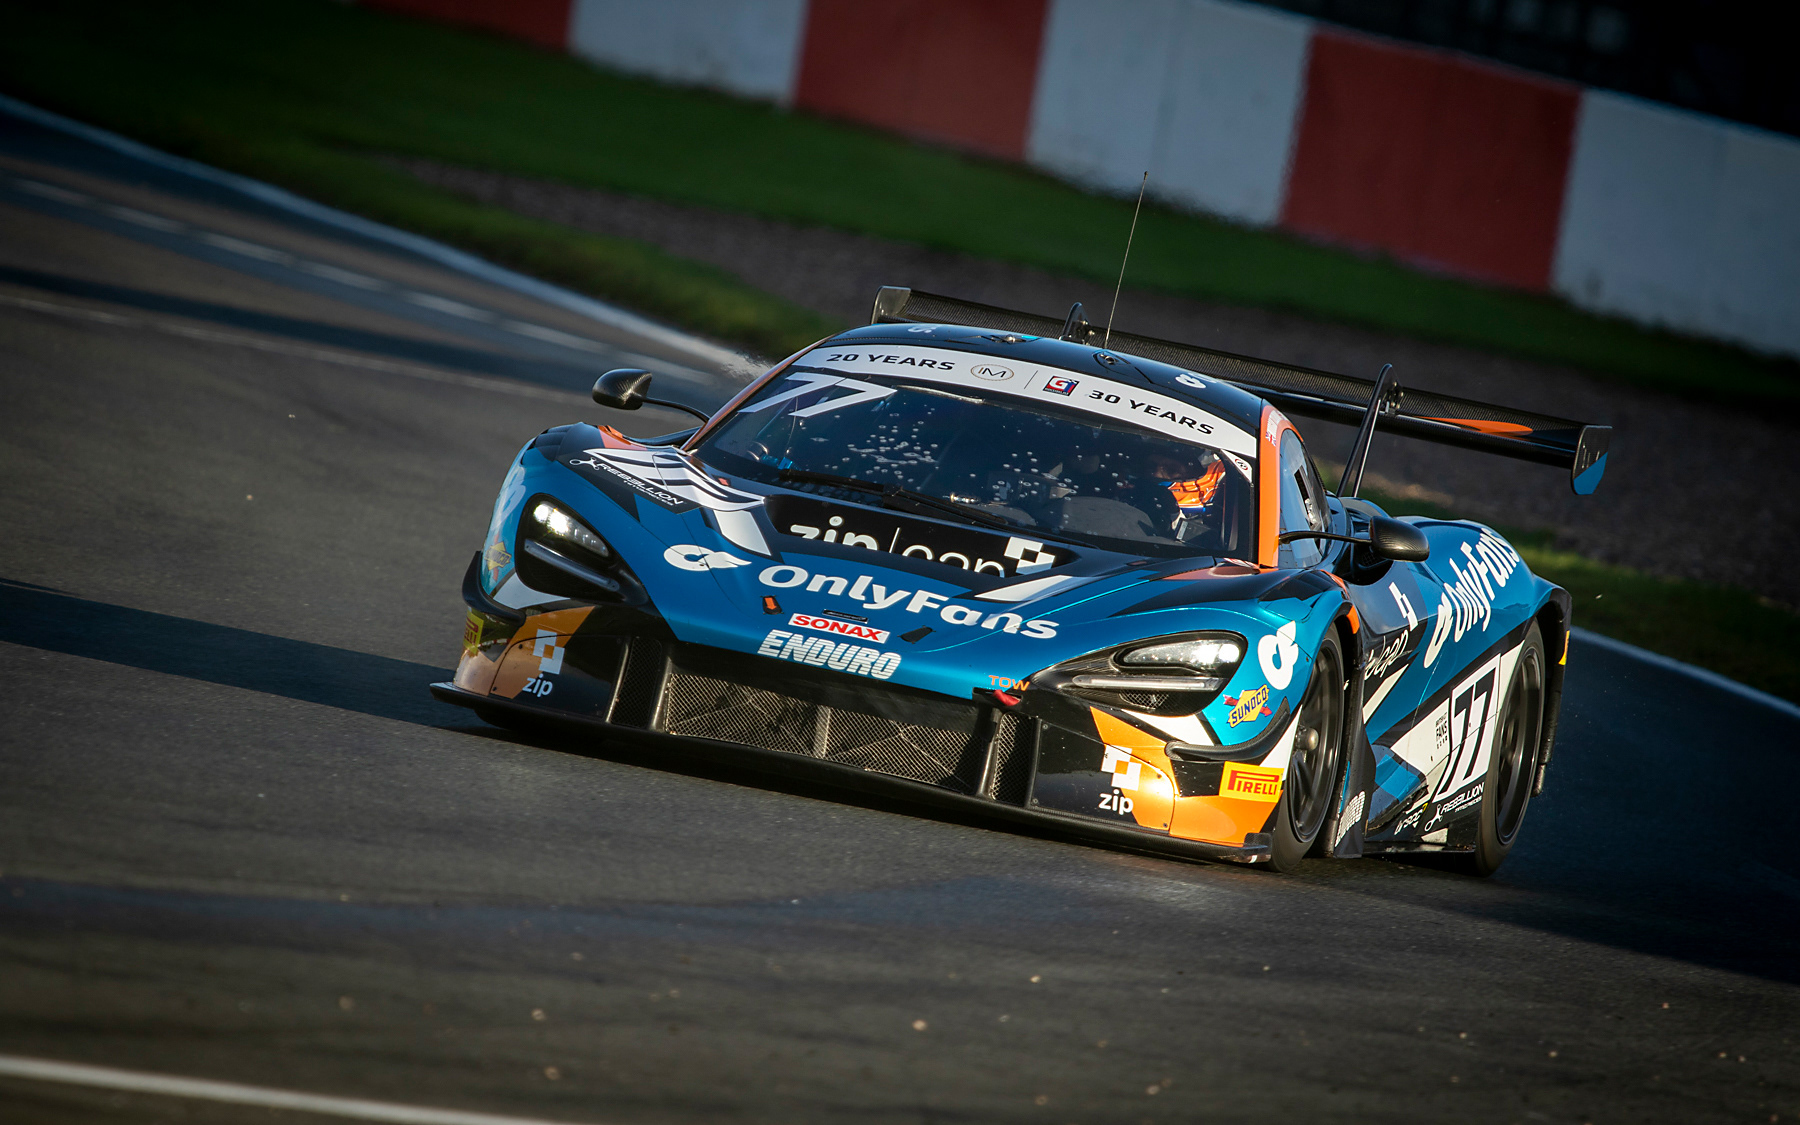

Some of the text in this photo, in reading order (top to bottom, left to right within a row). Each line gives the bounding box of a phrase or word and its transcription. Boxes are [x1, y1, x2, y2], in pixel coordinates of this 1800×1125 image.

[826, 353, 956, 372] 20 YEARS
[737, 371, 898, 418] 77
[1088, 389, 1215, 435] 30 YEARS
[598, 463, 684, 505] REBELLION
[757, 564, 1061, 640] OnlyFans
[1443, 527, 1520, 643] OnlyFans
[792, 614, 884, 642] SONAX
[756, 628, 903, 680] ENDURO
[522, 673, 554, 697] zip
[988, 674, 1030, 692] TOW
[1230, 686, 1269, 725] SUNOCO
[1436, 666, 1499, 796] 77
[1098, 789, 1134, 815] zip
[1226, 769, 1281, 796] PIRELLI
[1440, 781, 1485, 815] REBELLION
